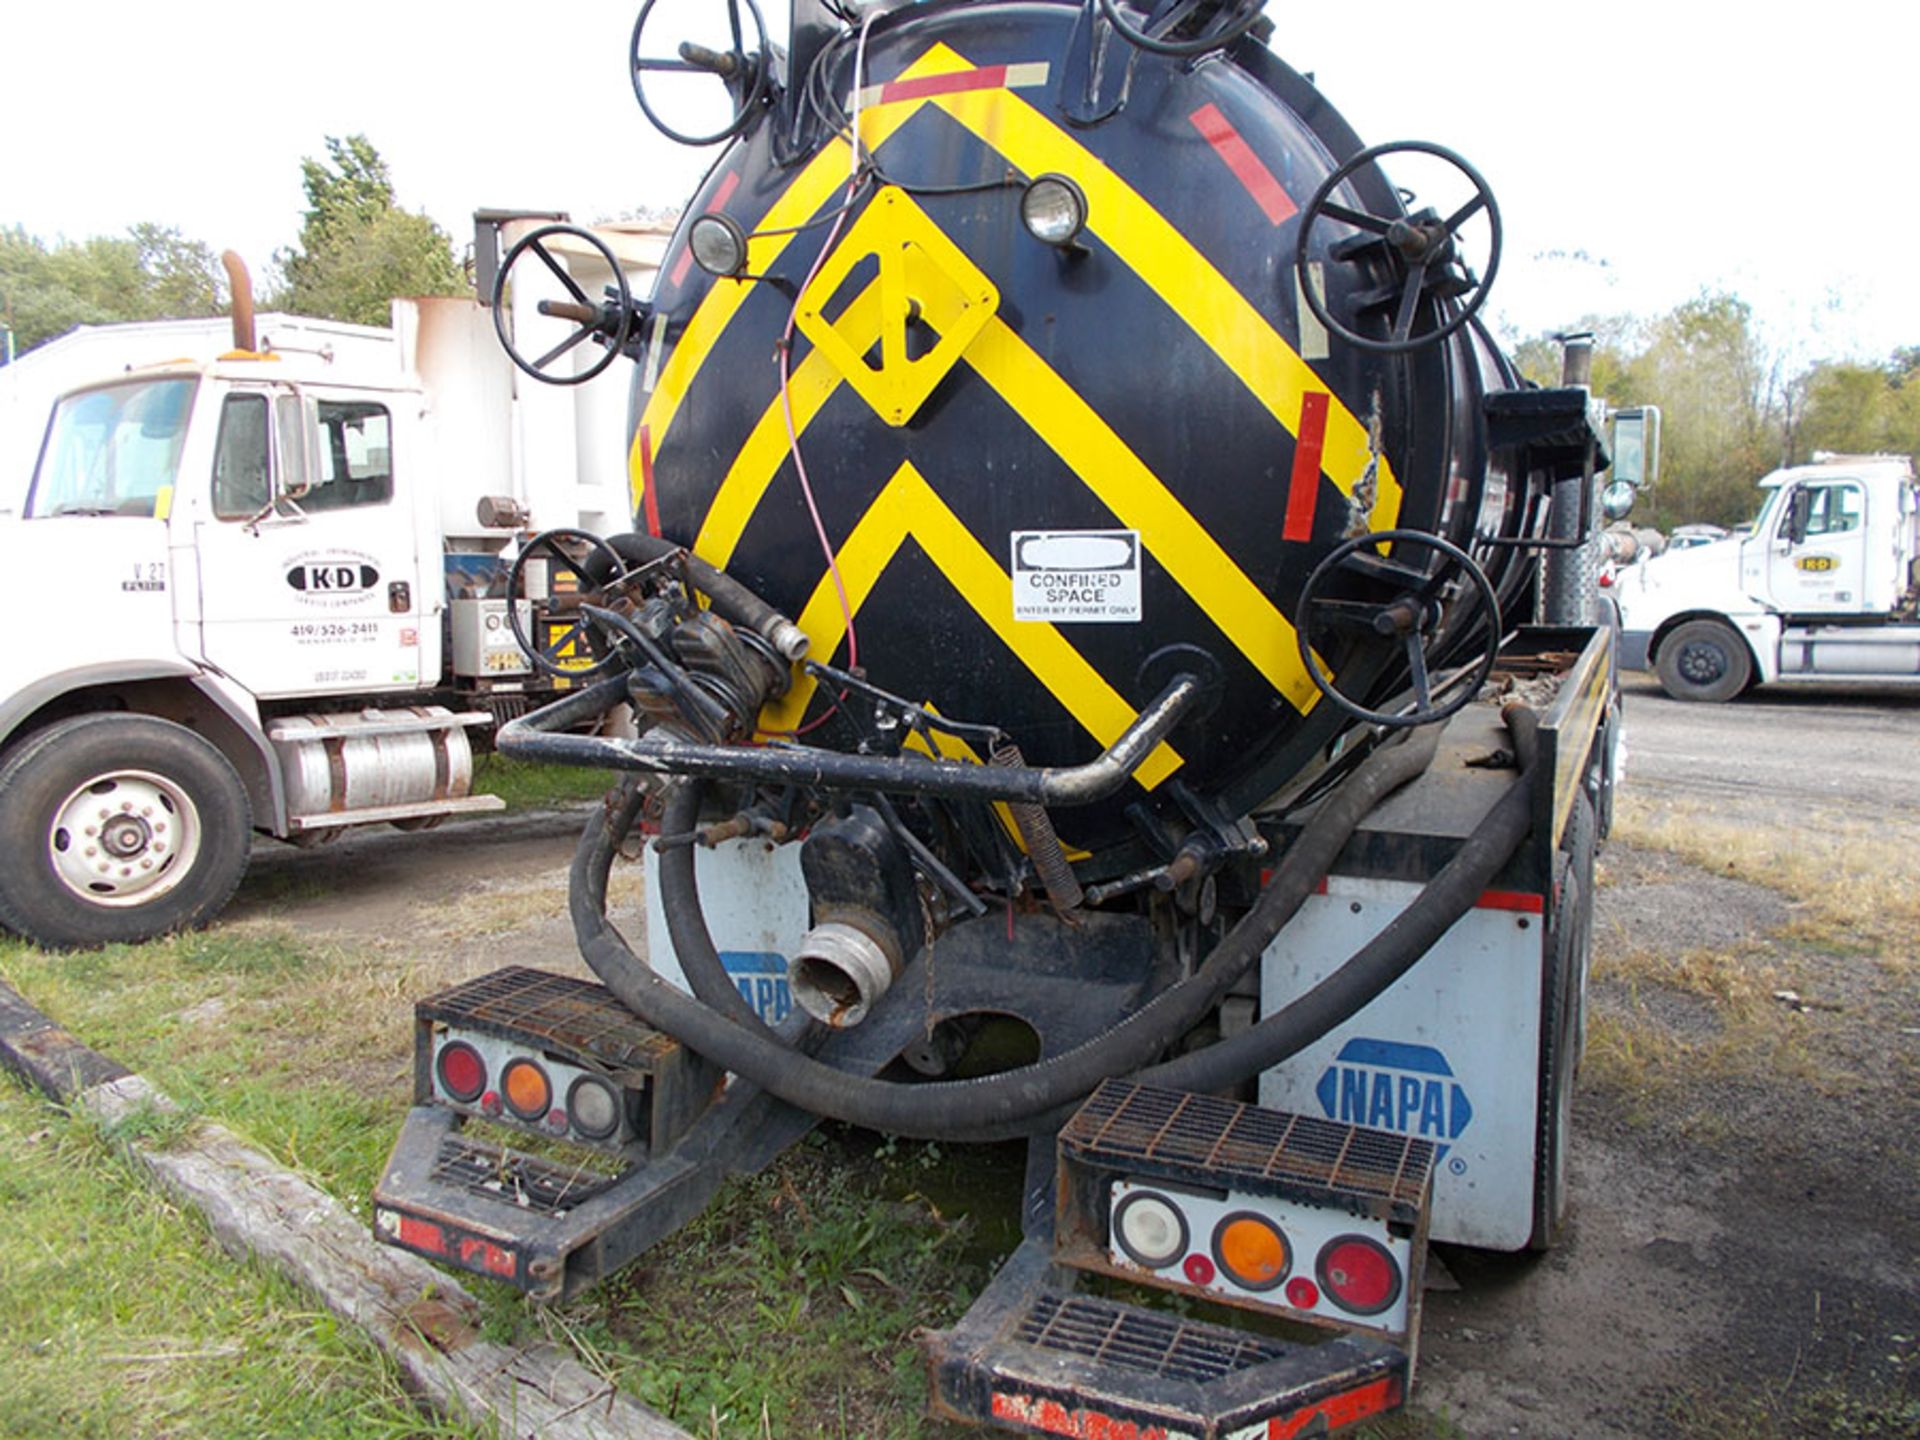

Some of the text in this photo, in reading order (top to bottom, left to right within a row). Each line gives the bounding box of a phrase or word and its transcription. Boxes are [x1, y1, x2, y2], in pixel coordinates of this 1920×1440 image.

[1030, 573, 1121, 588] CONFINED
[1046, 588, 1105, 603] SPACE
[1016, 606, 1050, 615] ENTER
[1067, 606, 1107, 615] PERMIT
[1108, 605, 1137, 615] ONLY
[737, 978, 792, 1021] APA
[1341, 1067, 1446, 1138] NAPA
